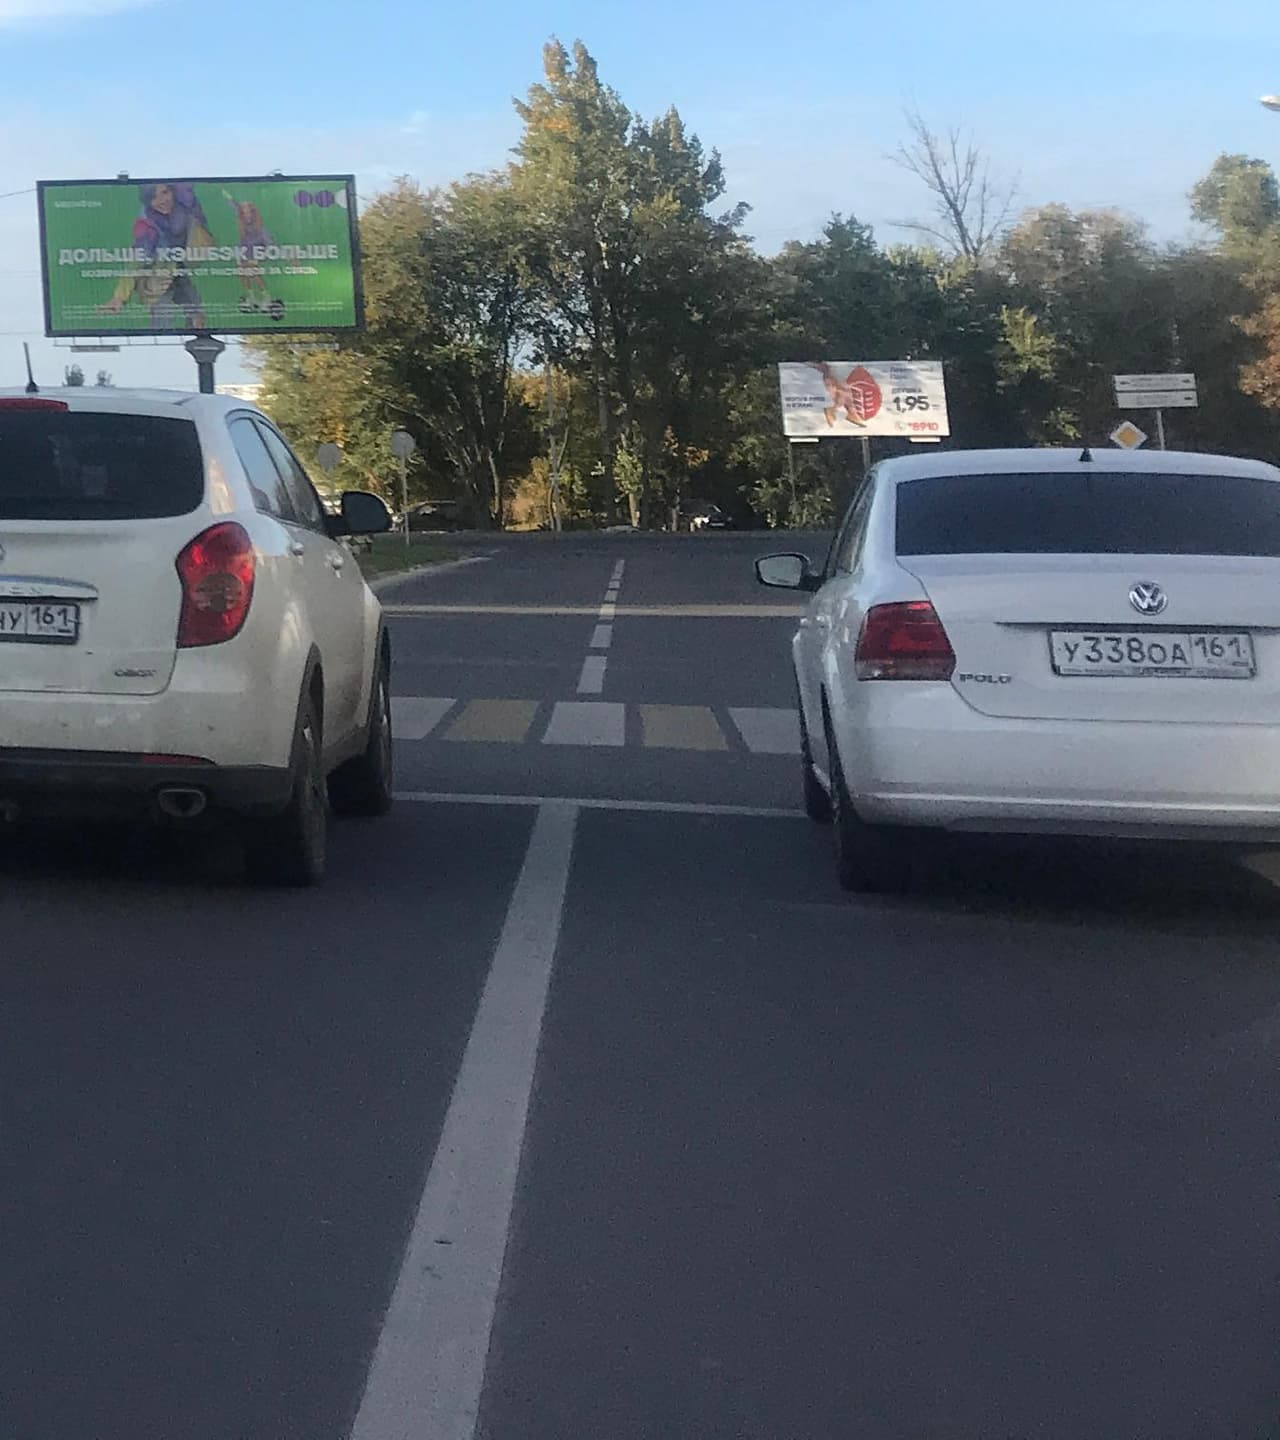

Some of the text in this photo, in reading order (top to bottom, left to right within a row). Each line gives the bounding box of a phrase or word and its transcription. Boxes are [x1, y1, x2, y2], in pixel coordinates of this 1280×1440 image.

[58, 244, 338, 266] ДОЛЬШЕ, КЭШБЭК БОЛЬШЕ
[893, 395, 930, 414] 1,95
[31, 606, 69, 627] 161
[1194, 636, 1241, 657] 161
[959, 672, 1011, 684] POLO
